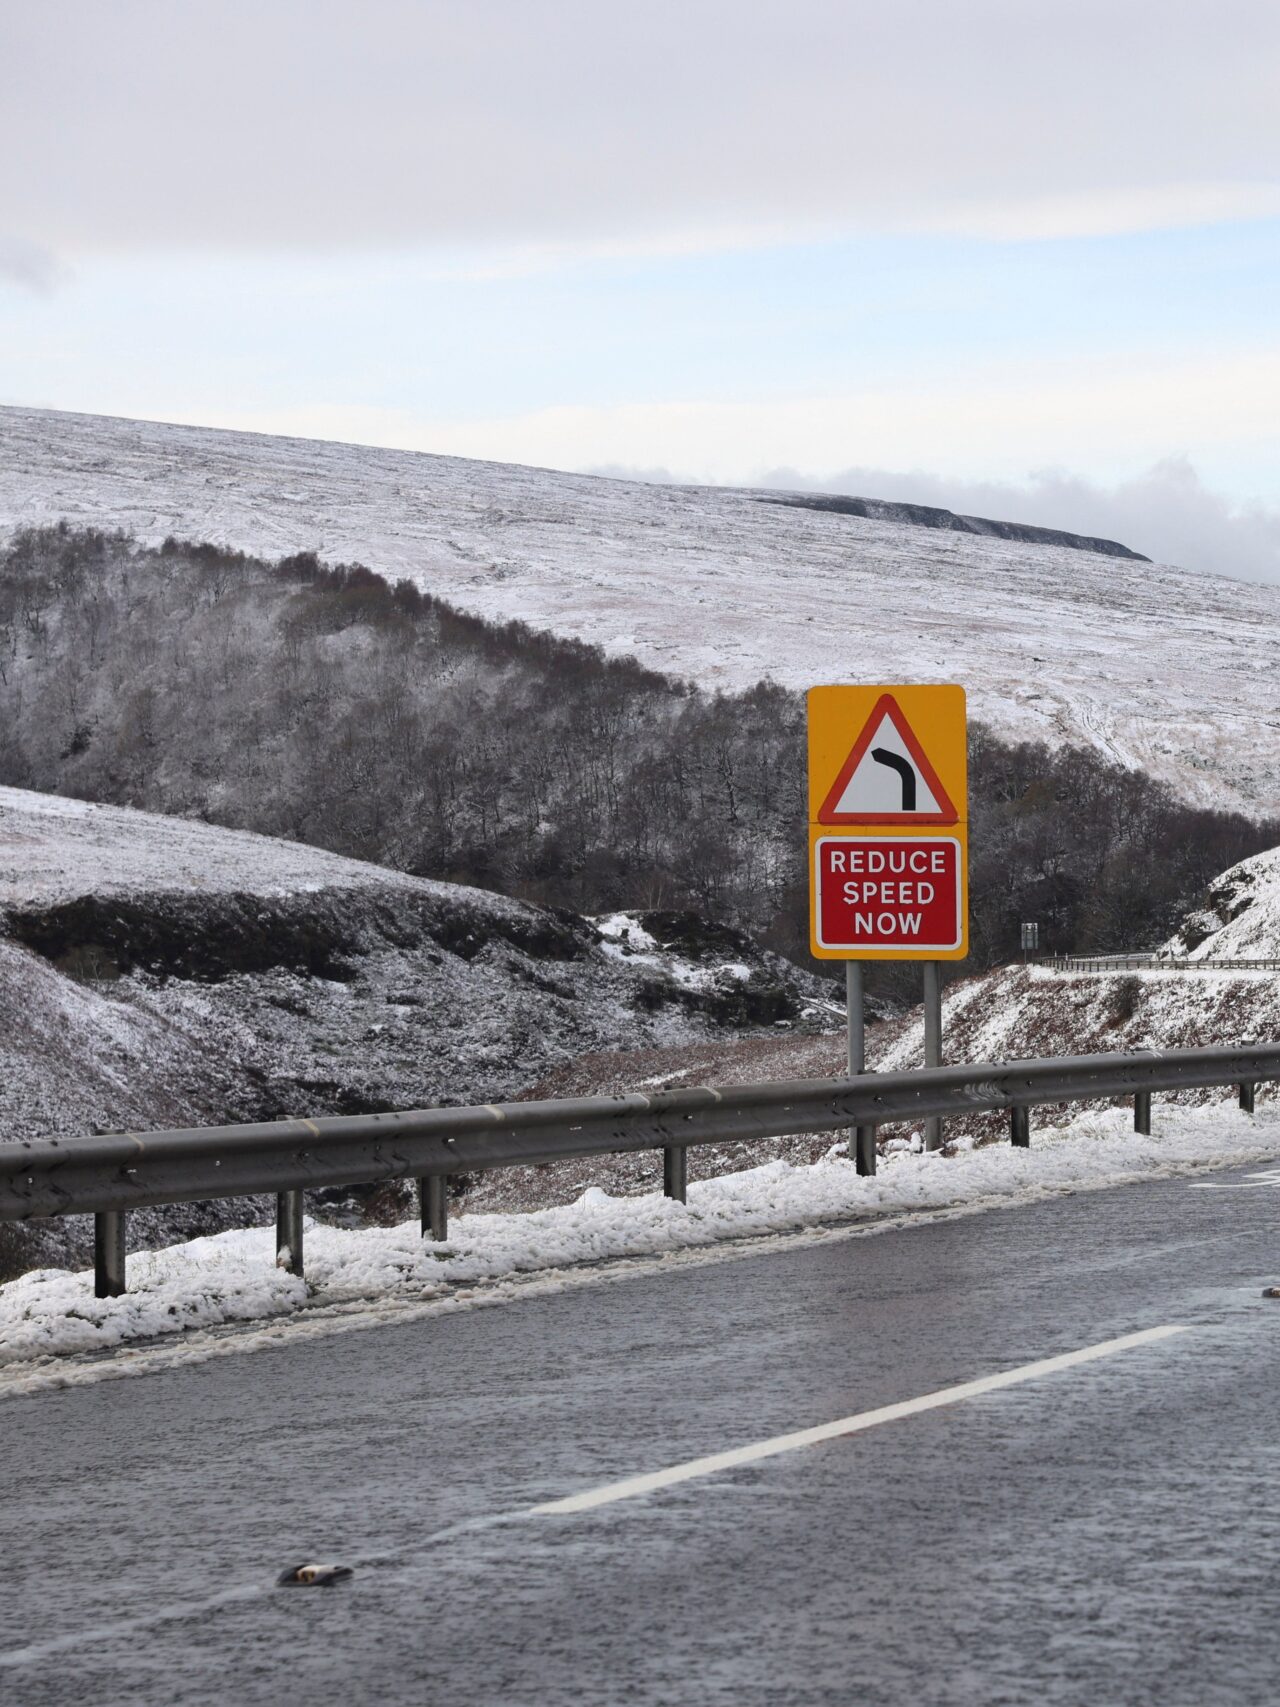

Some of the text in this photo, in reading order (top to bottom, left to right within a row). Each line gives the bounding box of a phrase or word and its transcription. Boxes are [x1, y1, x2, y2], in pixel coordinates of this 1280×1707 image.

[830, 851, 945, 873] REDUCE
[843, 881, 934, 904] SPEED
[855, 912, 922, 935] NOW
